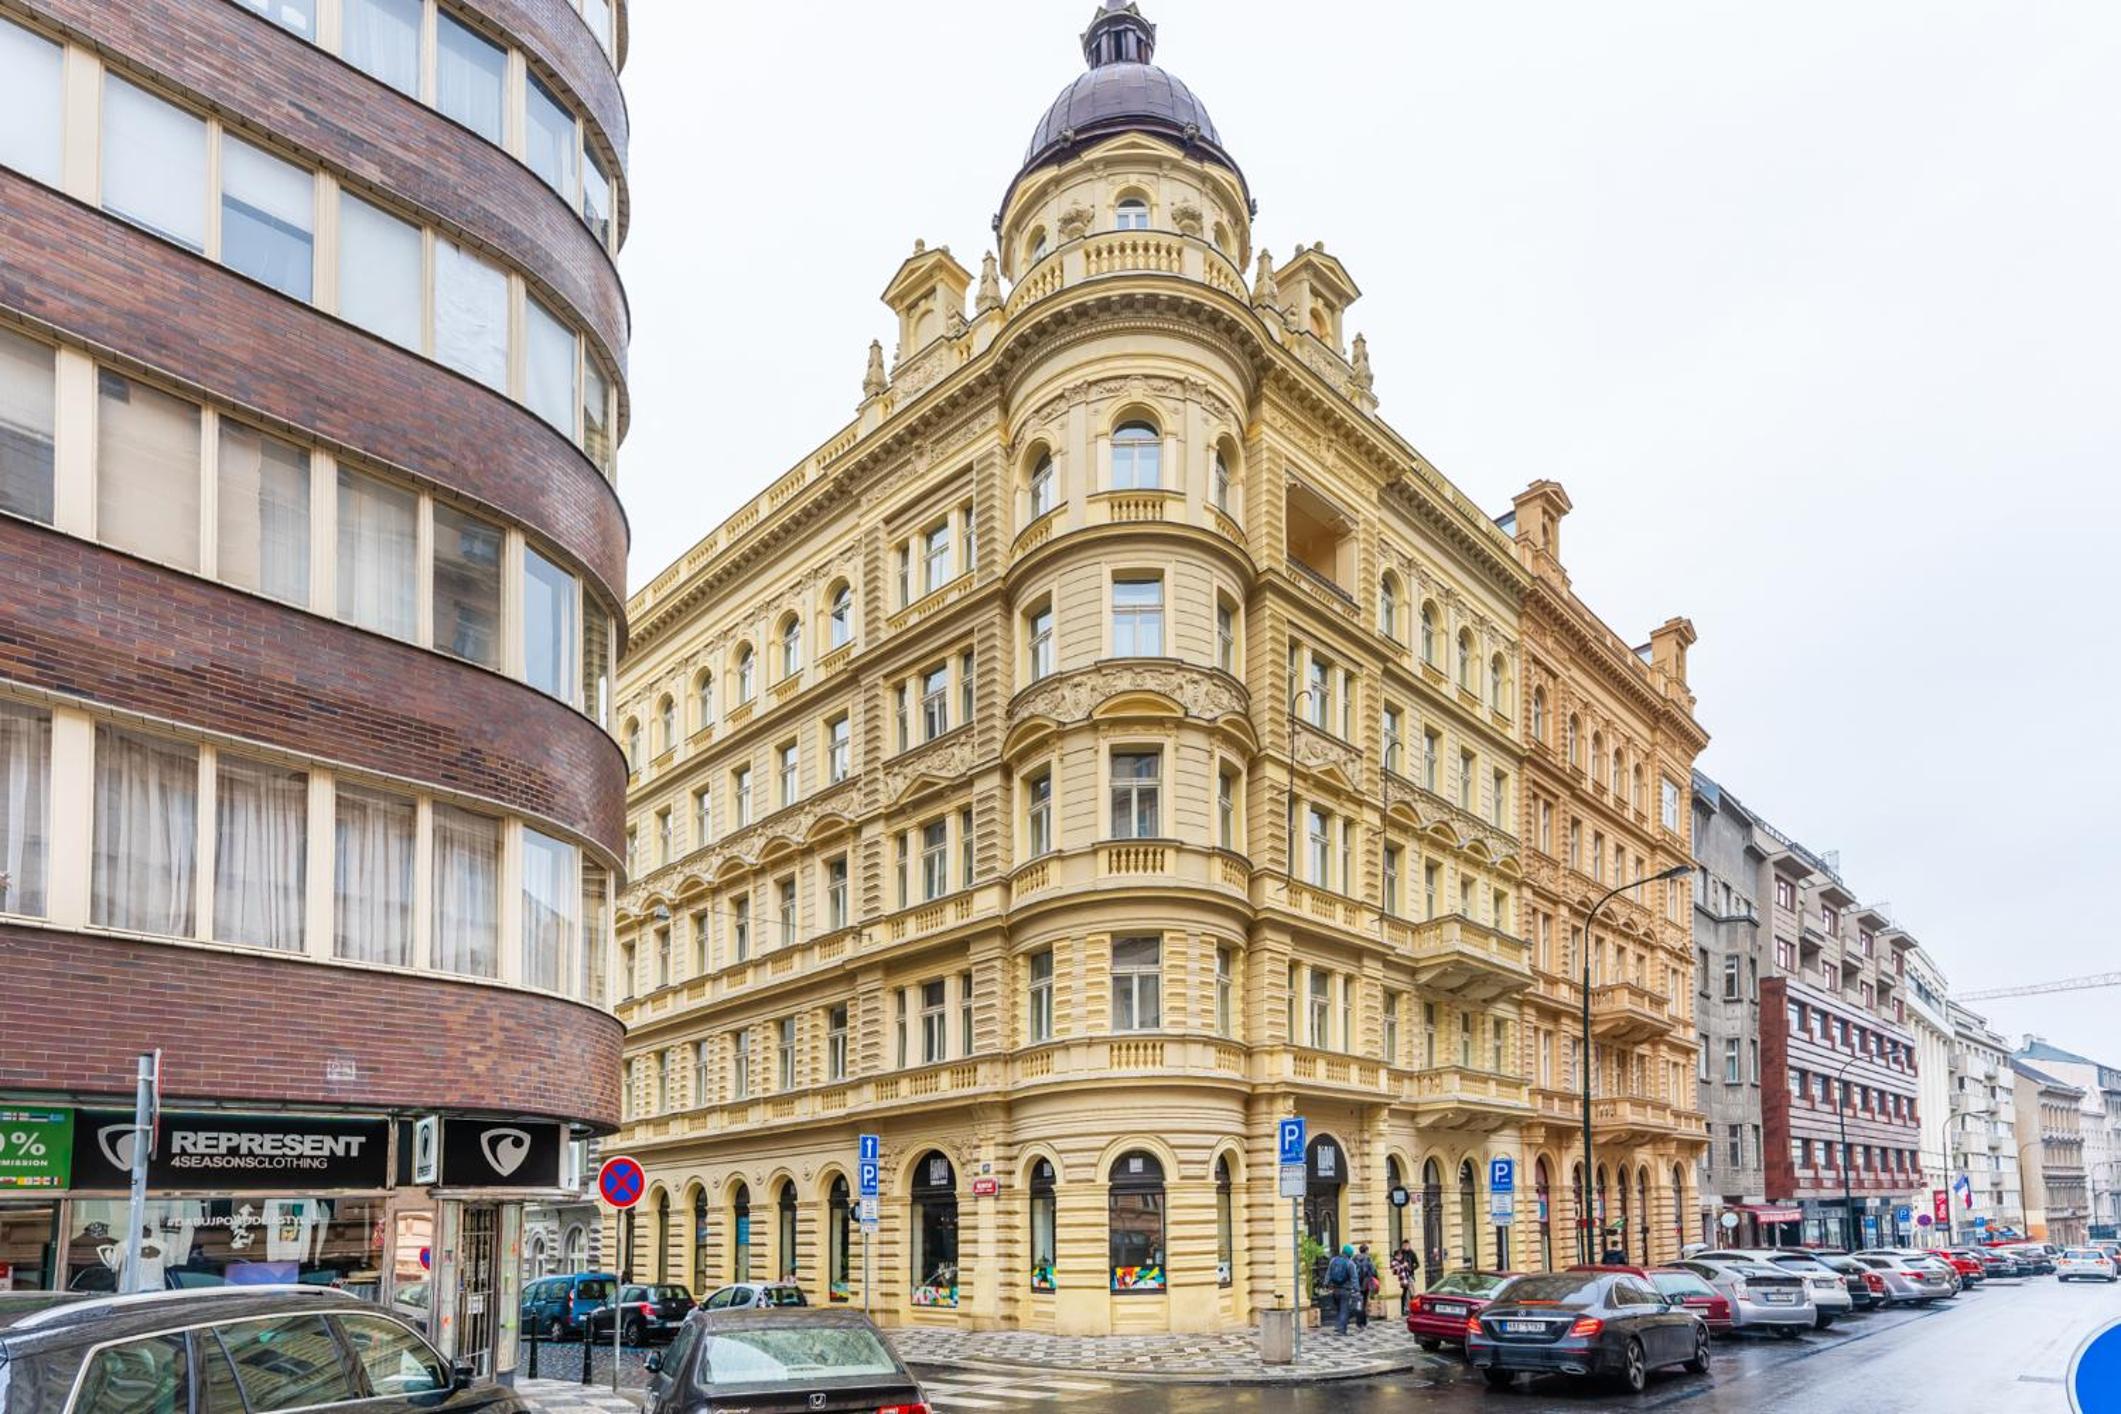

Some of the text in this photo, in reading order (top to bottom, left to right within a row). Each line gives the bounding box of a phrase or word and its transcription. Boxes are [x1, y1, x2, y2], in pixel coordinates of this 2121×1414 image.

[171, 1131, 366, 1157] REPRESENT
[1285, 1125, 1299, 1150] P
[170, 1156, 328, 1169] 4SEASONSCLOTHING
[1495, 1163, 1509, 1182] P
[863, 1165, 875, 1186] P
